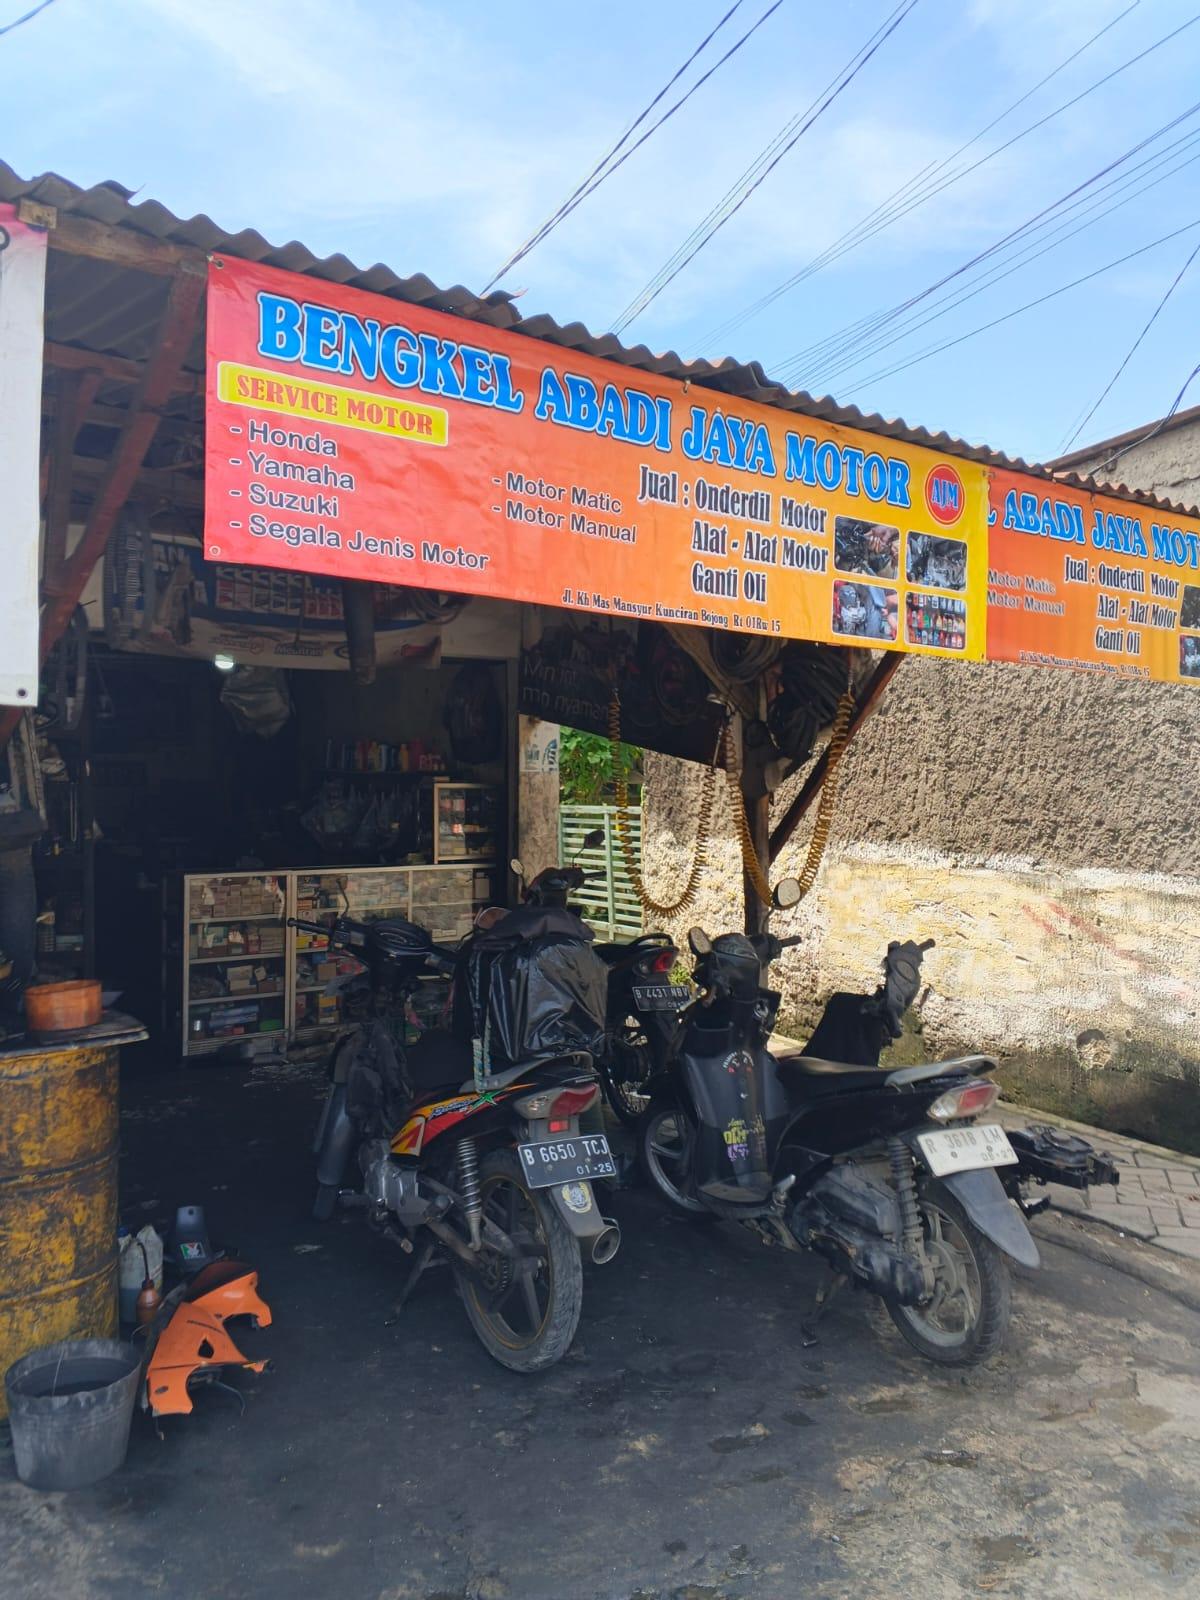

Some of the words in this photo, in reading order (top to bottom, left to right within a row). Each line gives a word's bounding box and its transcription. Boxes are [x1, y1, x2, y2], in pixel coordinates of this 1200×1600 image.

[237, 375, 338, 416] SERVICE
[347, 398, 433, 435] MOTOR
[257, 290, 524, 412] BENGKEL
[535, 366, 671, 452] ABADI
[682, 406, 776, 476] JAYA
[784, 430, 911, 508] MOTOR
[249, 420, 338, 456] Honda
[248, 451, 355, 490] Yamaha
[249, 483, 339, 517] Suzuki
[507, 471, 566, 501] Motor
[571, 486, 622, 513] Matic
[638, 465, 678, 504] Jual
[694, 478, 772, 523] Onderdil
[780, 496, 828, 534] Motor
[930, 478, 959, 511] AJM
[249, 515, 342, 548] Segala
[348, 530, 415, 559] Jenis
[422, 542, 490, 570] Motor
[506, 500, 565, 528] Motor
[570, 513, 637, 543] Manual
[1003, 489, 1086, 544] ABADI
[1091, 510, 1149, 558] JAYA
[1151, 523, 1200, 569] MOT
[691, 519, 727, 555] Alat
[743, 530, 778, 565] Alat
[781, 538, 829, 573] Motor
[691, 561, 738, 598] Ganti
[743, 570, 767, 603] Oli
[1064, 555, 1088, 584] Jual
[1098, 562, 1145, 593] Onderdil
[1150, 573, 1180, 599] Motor
[577, 591, 590, 606] Kh
[592, 593, 610, 609] Mas
[613, 597, 652, 616] Mansyur
[655, 603, 699, 621] Kunciran
[701, 609, 728, 628] Bojong
[733, 614, 744, 628] Rt
[771, 619, 781, 632] 15
[1096, 594, 1119, 619] Alat
[1128, 600, 1149, 624] Alat
[1150, 604, 1178, 629] Motor
[1095, 626, 1123, 651] Ganti
[1126, 631, 1141, 655] Oli
[525, 1149, 535, 1165] B
[540, 1143, 576, 1163] 6650
[582, 1139, 609, 1157] TCJ
